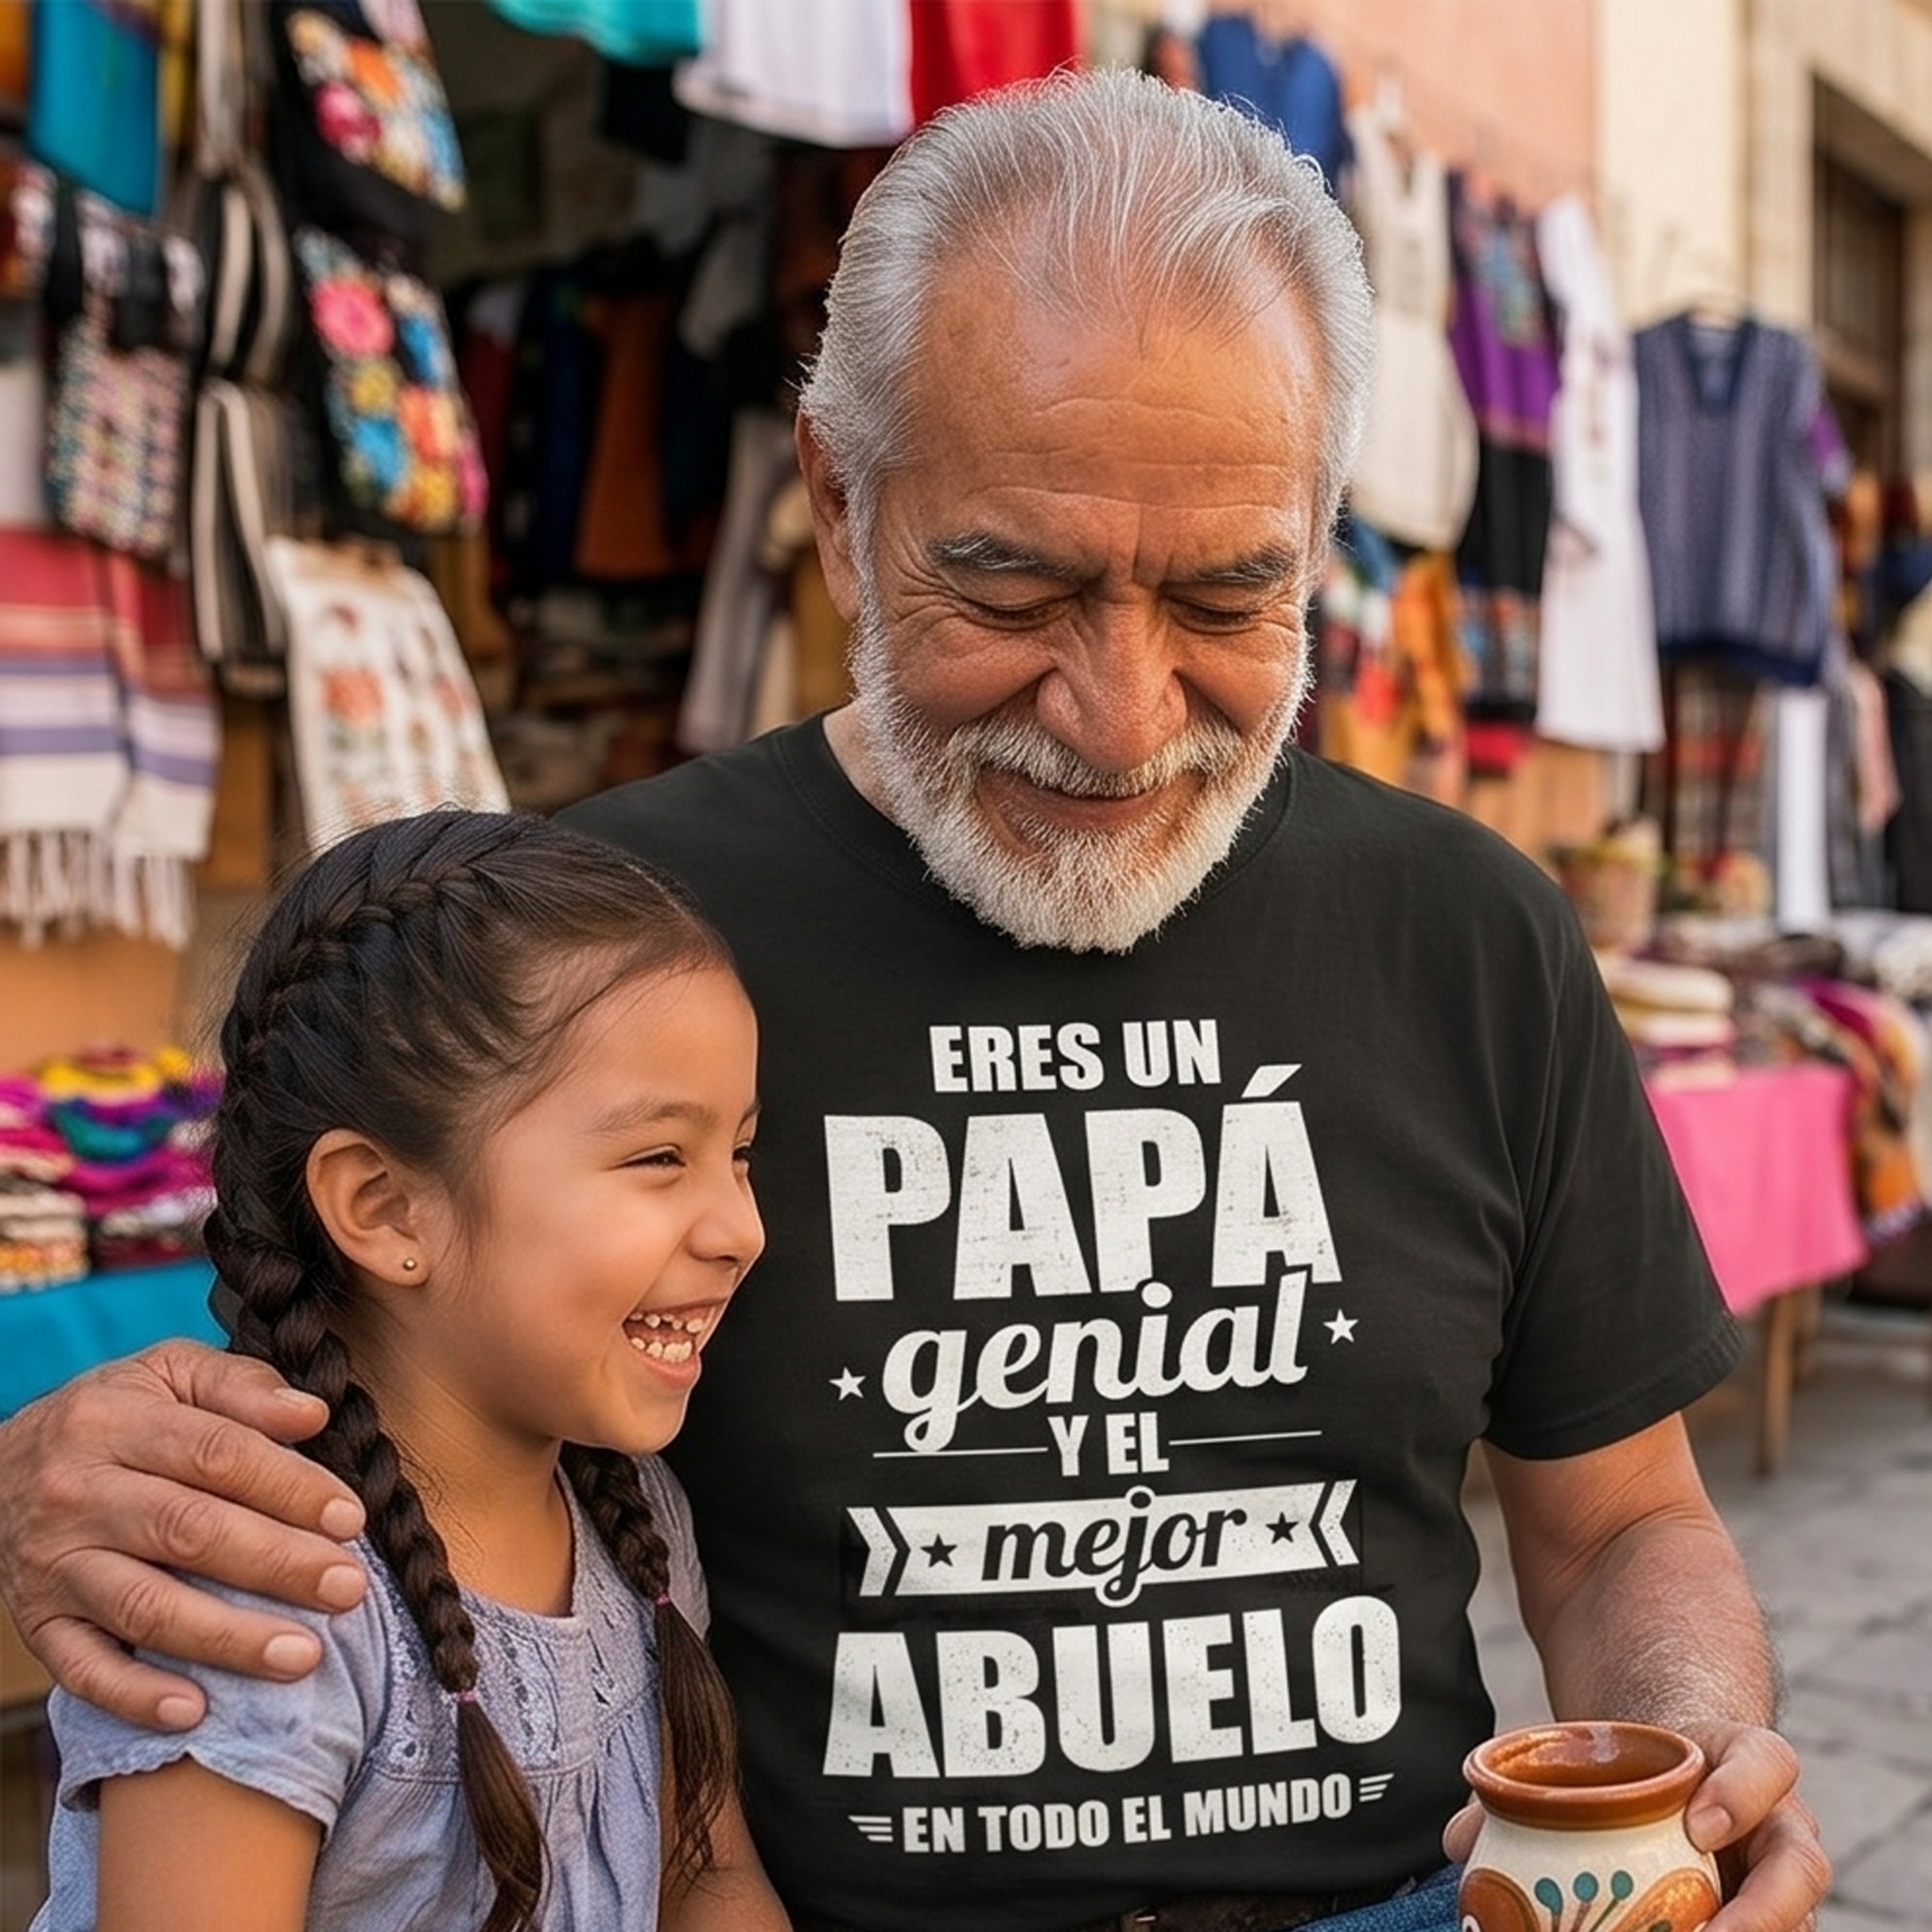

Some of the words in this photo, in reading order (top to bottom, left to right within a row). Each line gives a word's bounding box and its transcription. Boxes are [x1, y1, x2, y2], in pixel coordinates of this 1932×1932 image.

[929, 1022, 1105, 1092] ERES
[1123, 1019, 1222, 1088] UN
[824, 1063, 1342, 1302] PAPÁ
[882, 1270, 1308, 1454] genial
[1047, 1415, 1090, 1476] Y
[1106, 1411, 1170, 1474] EL
[981, 1490, 1248, 1601] mejor
[823, 1595, 1402, 1778] ABUELO
[903, 1807, 966, 1853] EN
[977, 1800, 1109, 1852] TODO
[1122, 1795, 1172, 1843] EL
[1183, 1773, 1352, 1837] MUNDO
